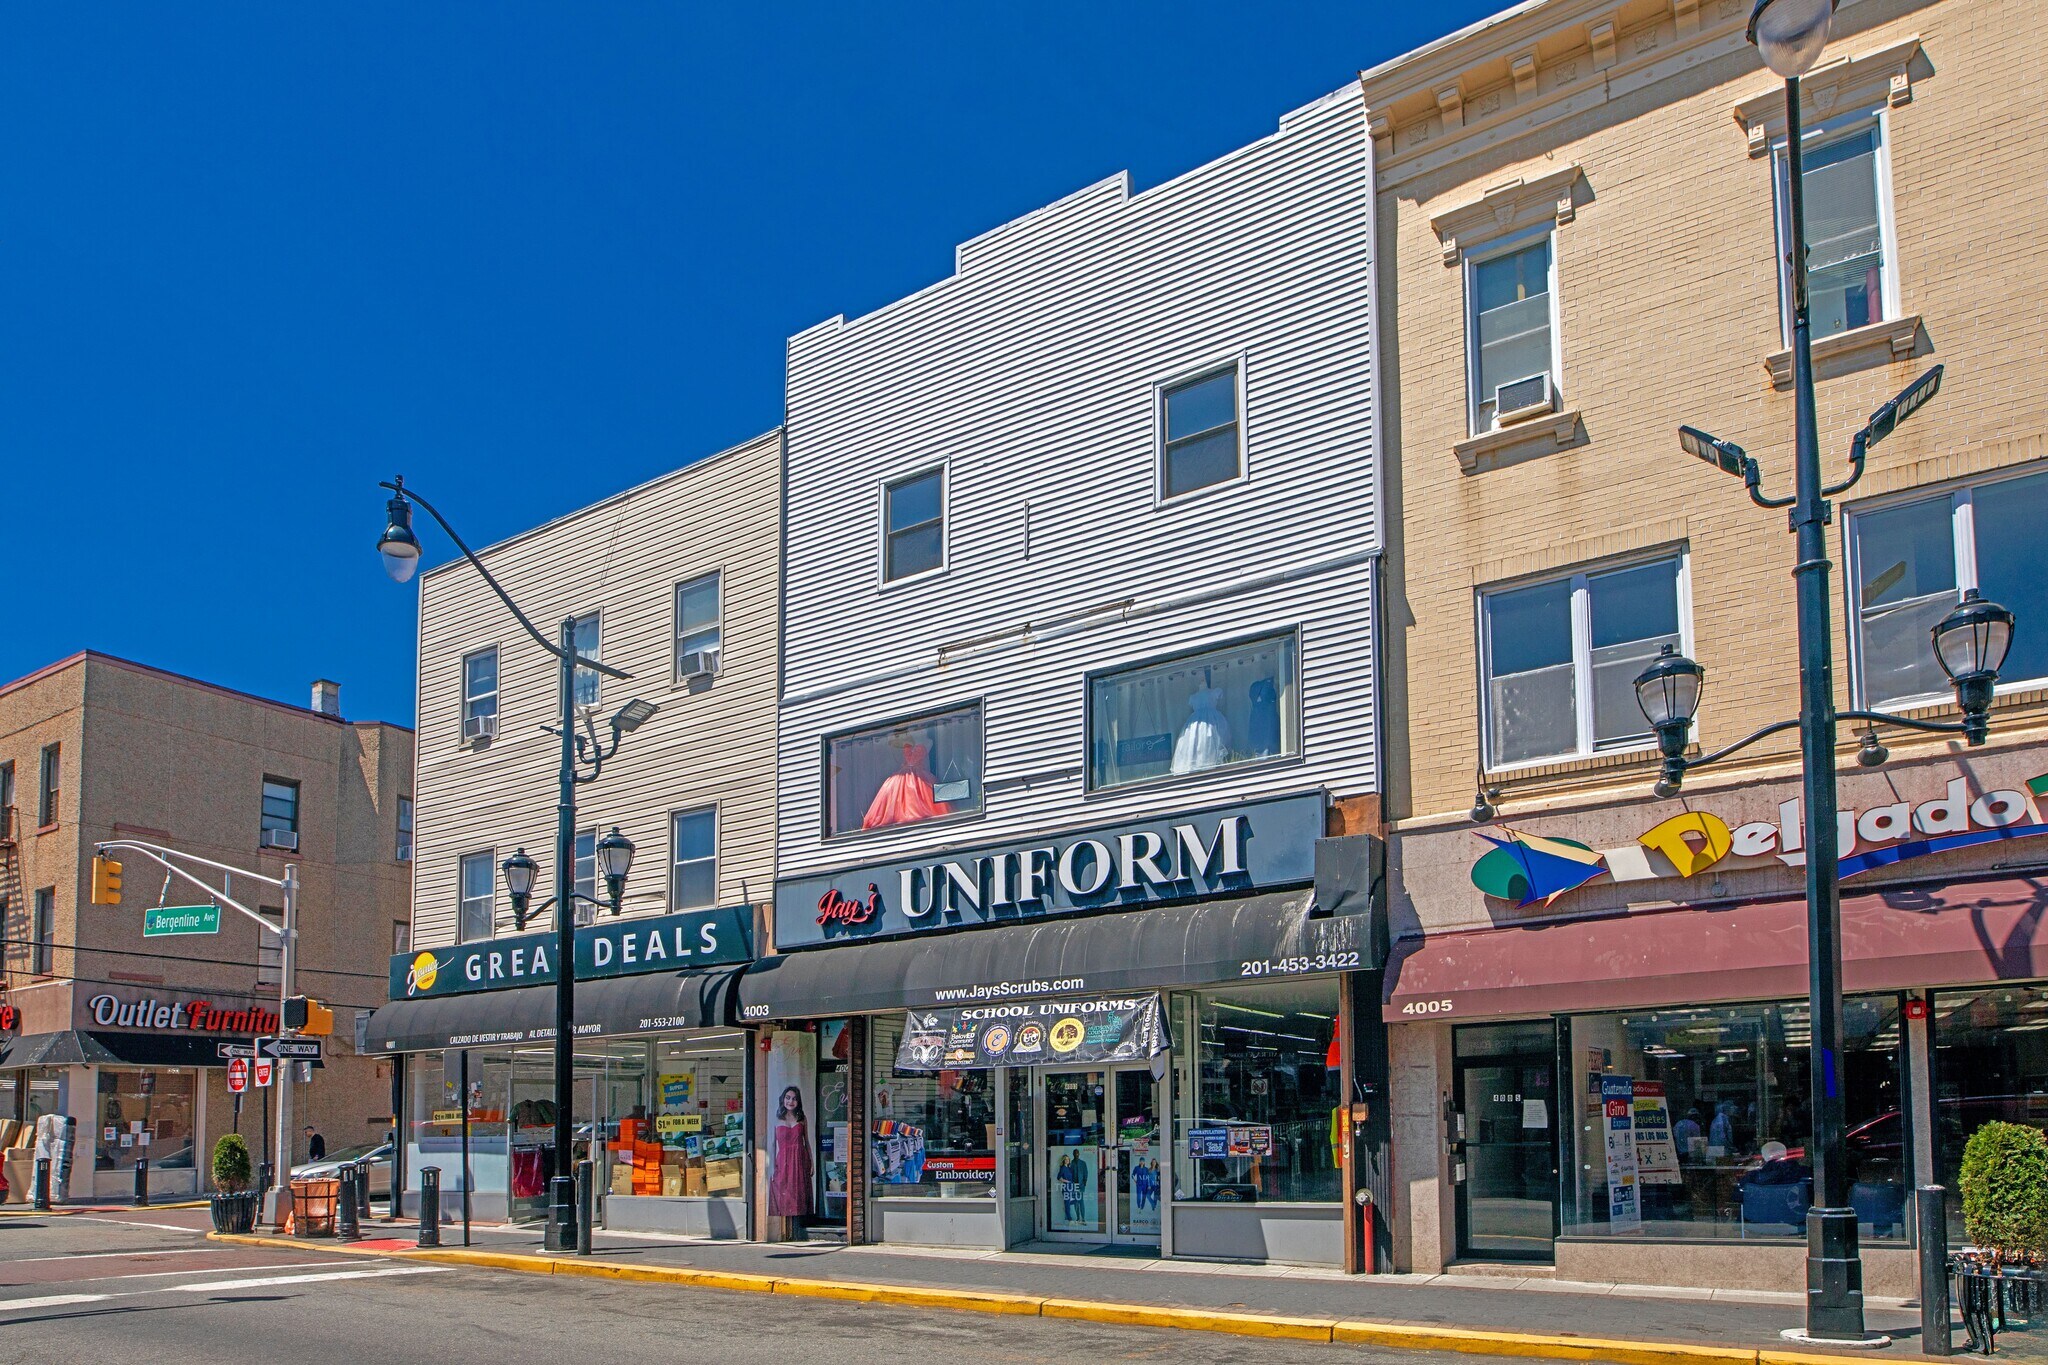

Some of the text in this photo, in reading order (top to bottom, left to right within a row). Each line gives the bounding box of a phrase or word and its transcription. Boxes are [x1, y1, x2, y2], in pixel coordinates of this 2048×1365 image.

[816, 815, 1247, 926] Jay's UNIFORM
[156, 912, 215, 932] Bergenline Ave
[465, 944, 558, 981] GREA
[594, 922, 717, 967] DEALS
[1241, 951, 1360, 976] 201-453-3422
[935, 977, 1084, 1000] www.JaysScrubs.com
[742, 1004, 769, 1017] 4003
[960, 999, 1138, 1020] SCHOOL UNIFORMS
[1402, 999, 1453, 1015] 4005
[89, 994, 280, 1034] Outlet Furnitu
[577, 1024, 601, 1034] MAYOR
[639, 1016, 685, 1029] 201-553-2100
[449, 1031, 523, 1045] CALZADO DE VESTIR Y TRABAJO
[528, 1028, 557, 1038] AL DETALL
[277, 1045, 315, 1053] ONE WAY
[258, 1067, 269, 1077] ENTER
[1602, 1080, 1632, 1095] Guatemala
[1608, 1100, 1625, 1116] Giro
[1126, 1116, 1140, 1124] NEW
[1612, 1117, 1630, 1129] Express
[1634, 1112, 1666, 1126] aquetes
[1645, 1132, 1655, 1140] LOS
[1658, 1152, 1667, 1161] 15
[927, 1161, 954, 1169] Custom
[935, 1170, 995, 1181] Embroidery
[1055, 1183, 1080, 1192] TRUE
